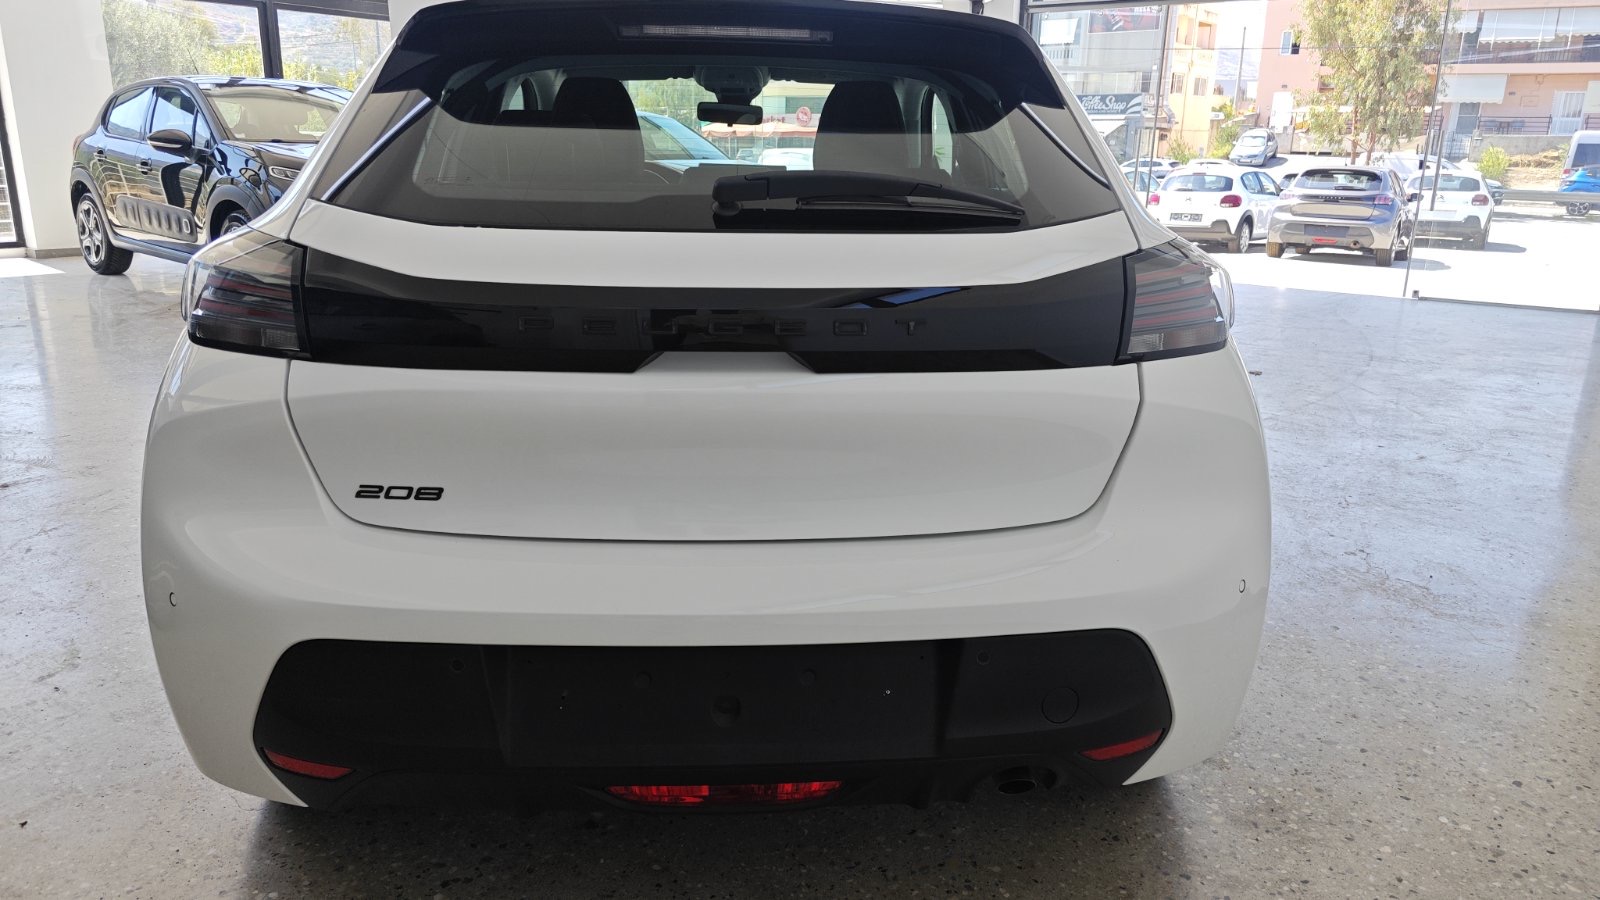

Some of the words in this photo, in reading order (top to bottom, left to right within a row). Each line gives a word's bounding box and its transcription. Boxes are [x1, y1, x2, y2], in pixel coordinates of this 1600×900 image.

[1105, 95, 1127, 112] Shop
[518, 315, 928, 337] PEUGEOT
[355, 484, 445, 501] 208
